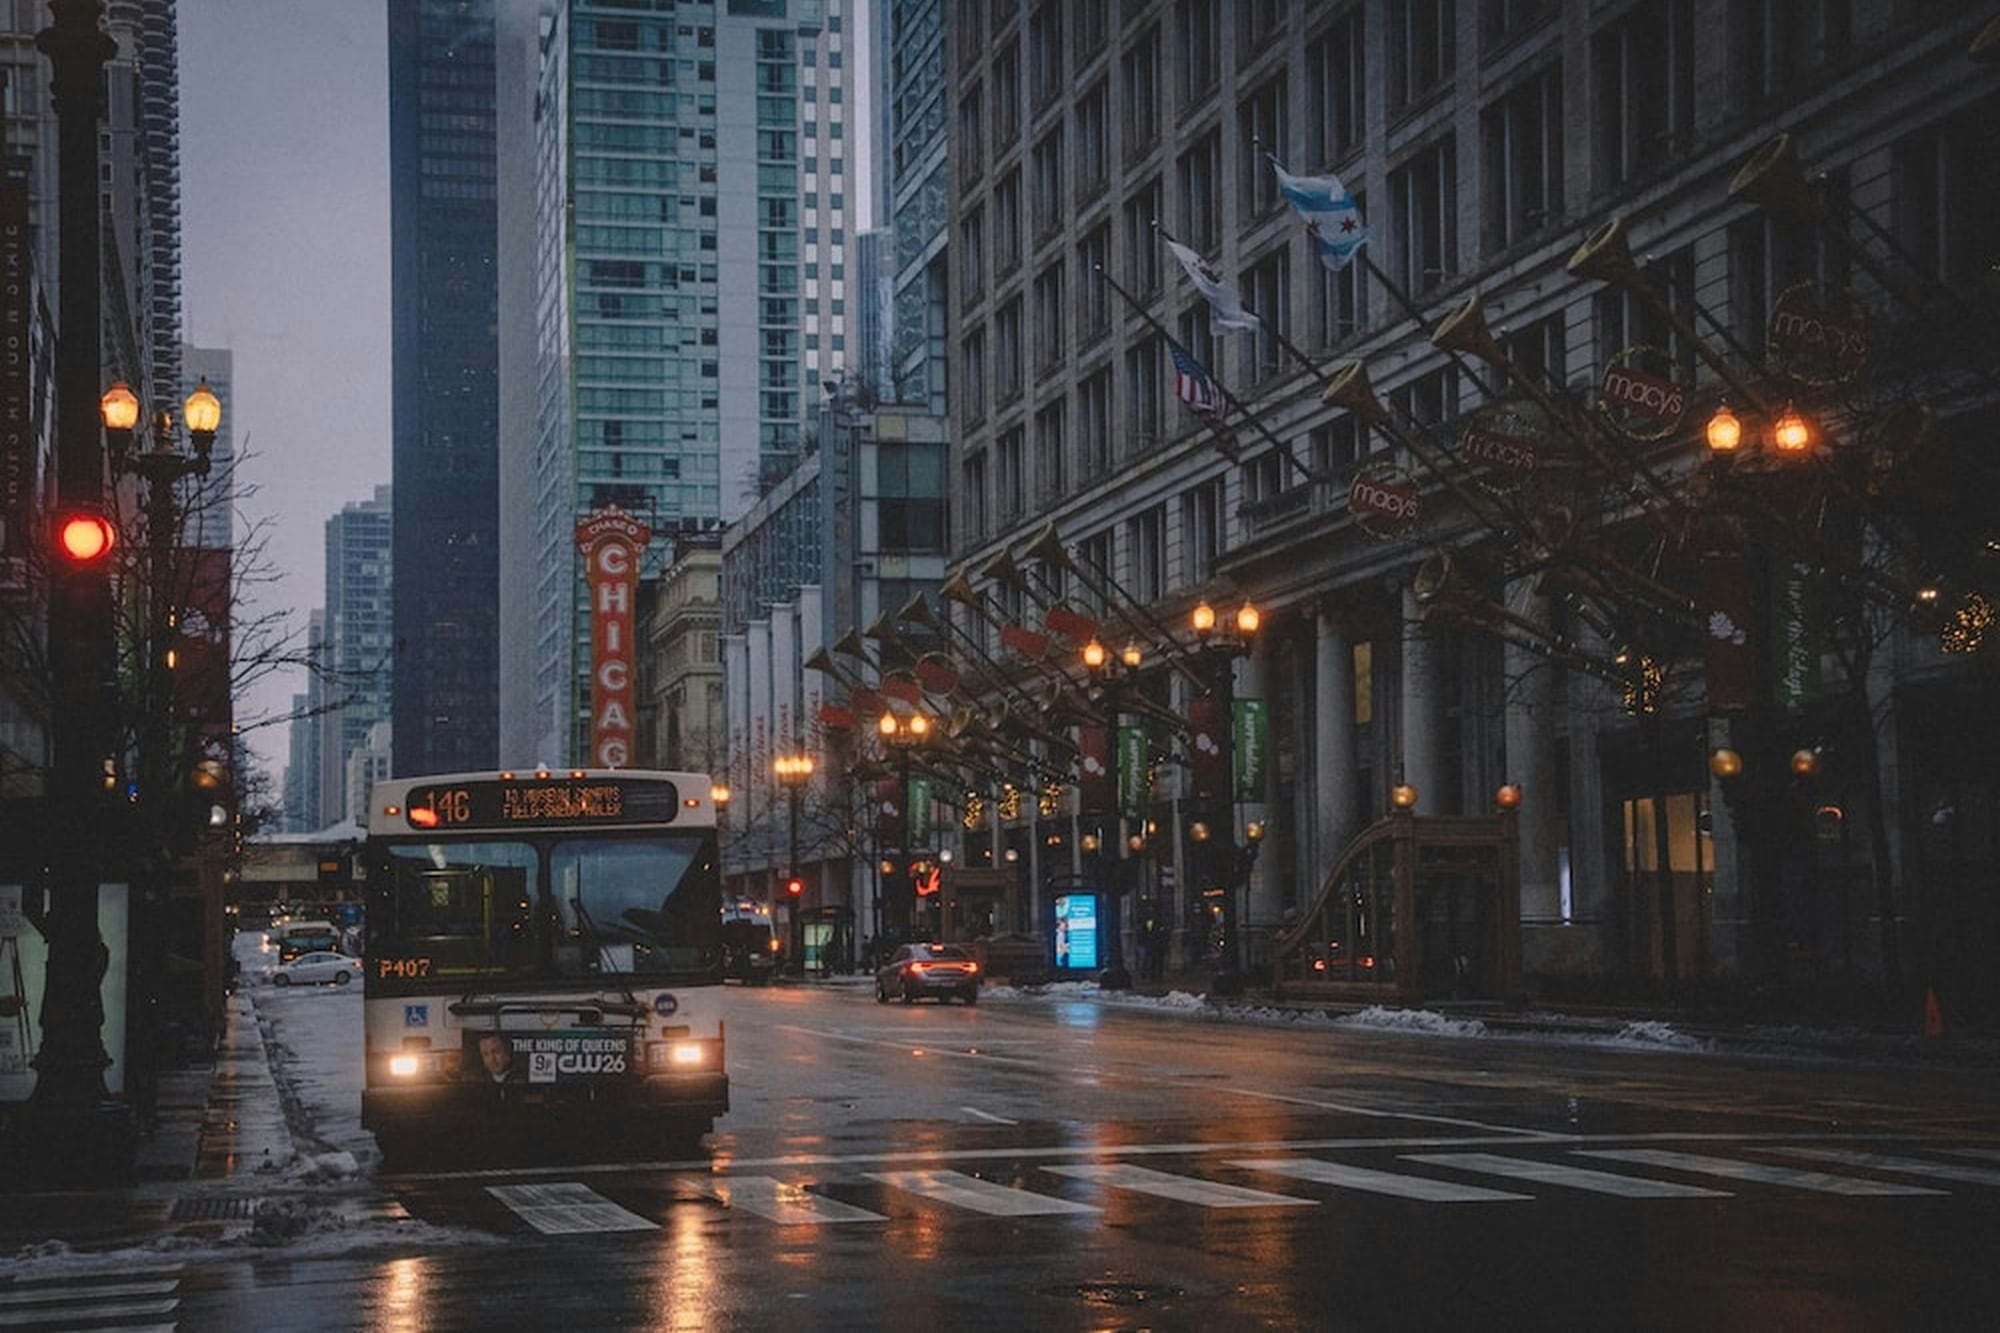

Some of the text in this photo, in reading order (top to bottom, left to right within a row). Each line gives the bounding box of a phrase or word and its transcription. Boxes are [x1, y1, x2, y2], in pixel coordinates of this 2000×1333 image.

[1604, 373, 1683, 415] macy's
[1353, 484, 1419, 519] macy's
[425, 790, 470, 822] 146
[379, 958, 430, 978] P407
[512, 1038, 534, 1052] THE
[564, 1038, 580, 1052] OF
[581, 1038, 627, 1053] QUEENS
